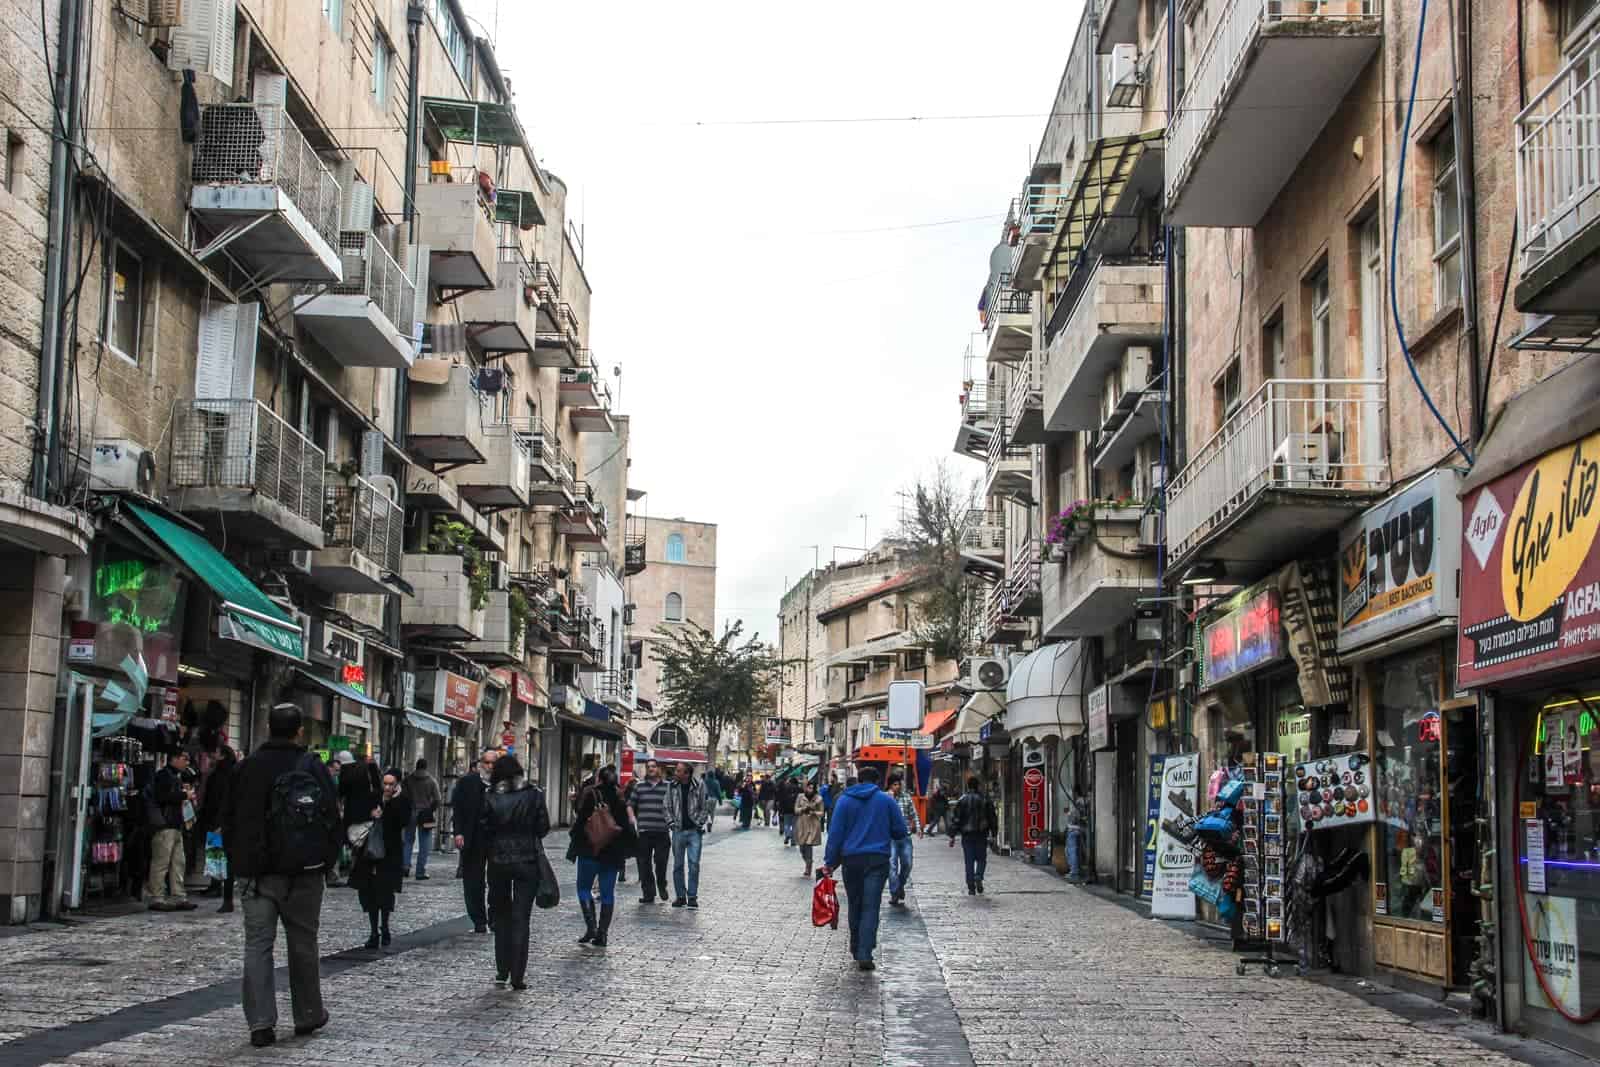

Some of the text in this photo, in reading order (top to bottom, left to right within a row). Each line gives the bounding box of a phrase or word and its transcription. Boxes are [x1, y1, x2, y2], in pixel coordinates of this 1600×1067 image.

[1558, 441, 1598, 539] פוטו
[1471, 510, 1497, 541] Agfa
[1389, 590, 1400, 605] BEST
[1401, 576, 1432, 601] BACKPACKS
[1564, 582, 1600, 621] AGFA
[1516, 624, 1539, 643] הצילום
